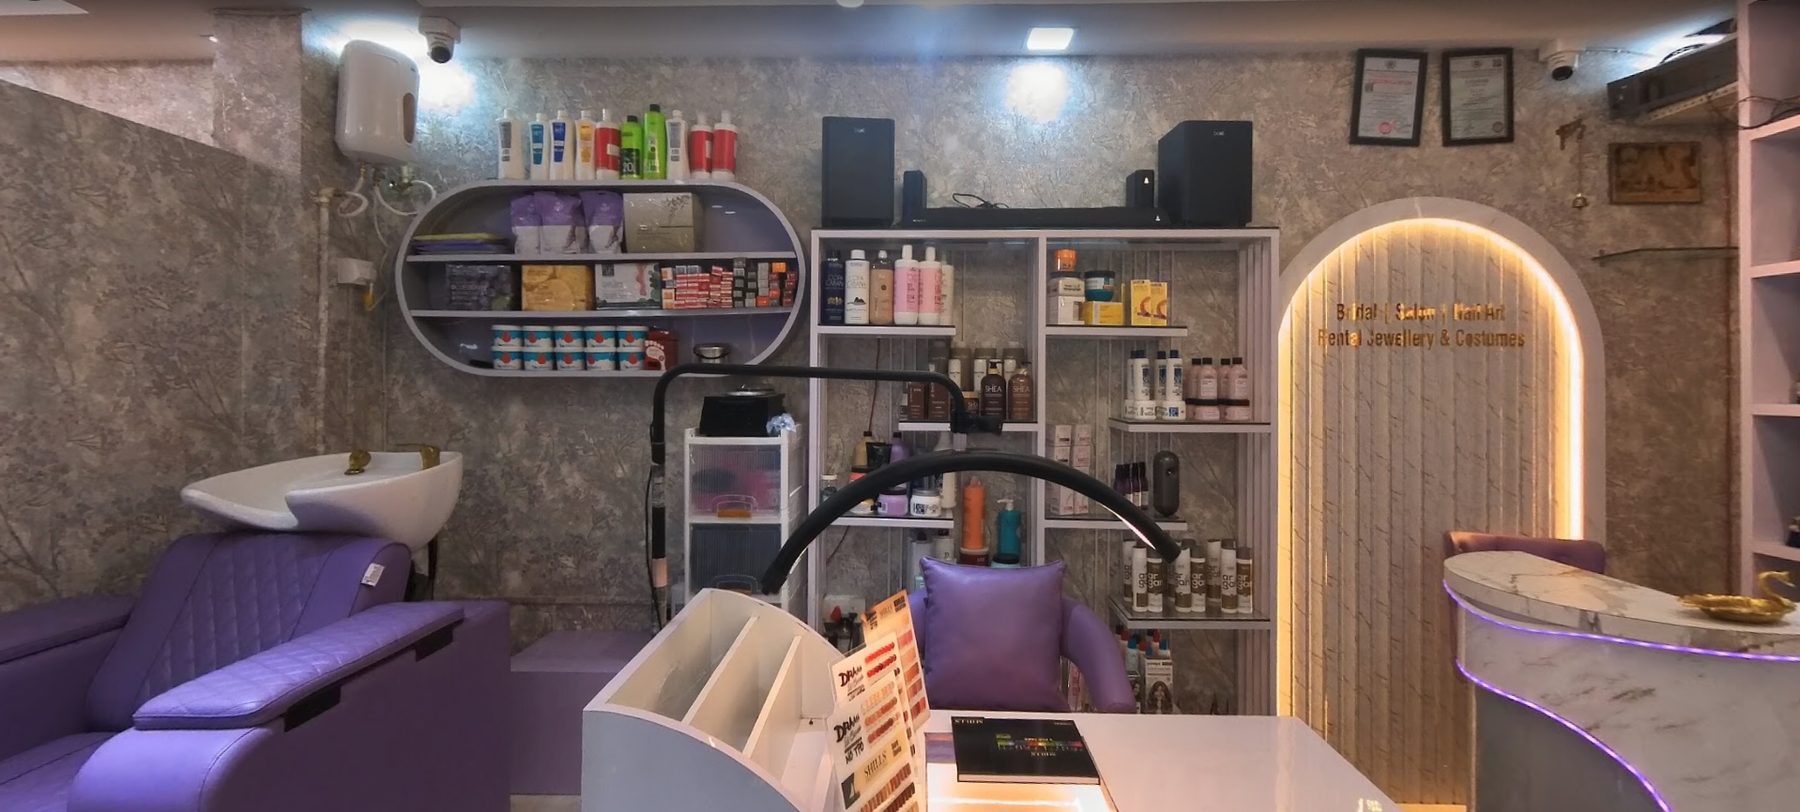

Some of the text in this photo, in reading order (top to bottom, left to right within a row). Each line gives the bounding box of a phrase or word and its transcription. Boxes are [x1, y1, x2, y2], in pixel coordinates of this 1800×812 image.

[1337, 303, 1377, 321] Bridal
[1395, 303, 1435, 321] Salon
[1318, 329, 1525, 350] Rental Jewellery & Costumes
